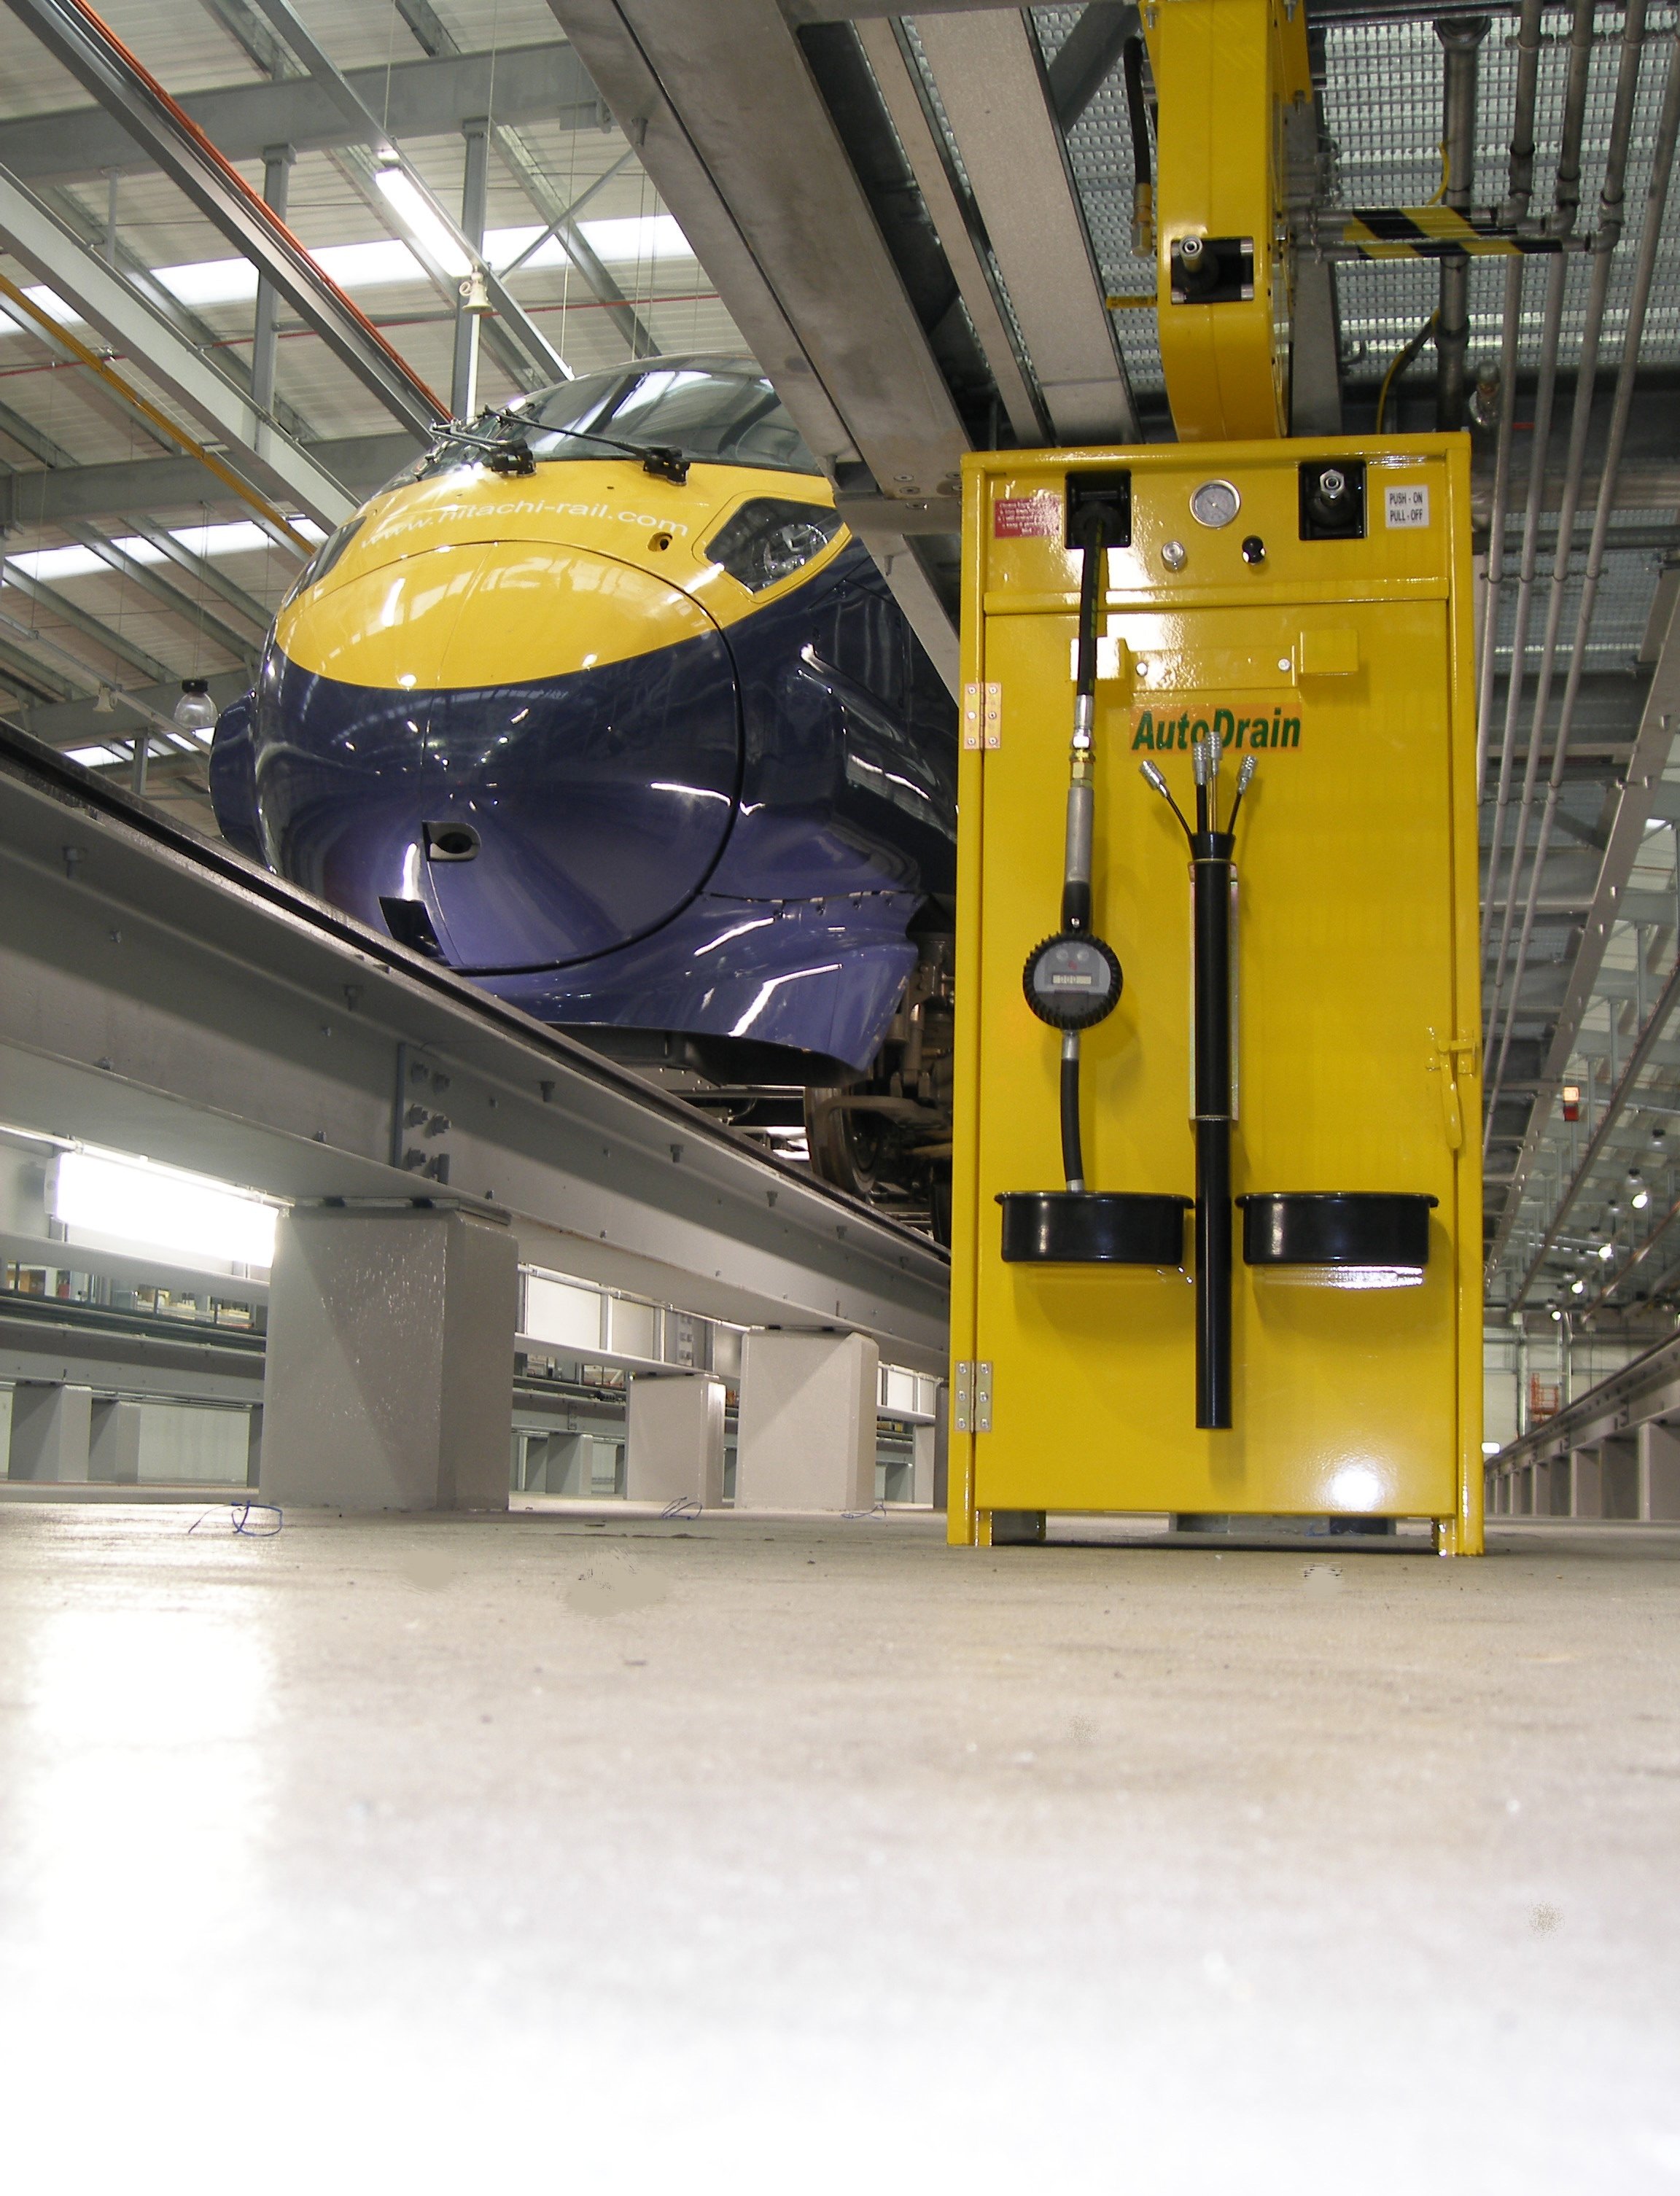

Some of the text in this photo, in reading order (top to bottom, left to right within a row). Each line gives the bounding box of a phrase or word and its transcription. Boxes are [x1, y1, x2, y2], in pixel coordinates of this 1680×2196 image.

[1389, 493, 1407, 505] PUSH
[1413, 491, 1423, 503] ON
[361, 499, 689, 548] www.hitachi-rail.com
[1390, 510, 1406, 521] PULL
[1410, 509, 1423, 521] OFF
[1132, 706, 1301, 750] AutoDrain
